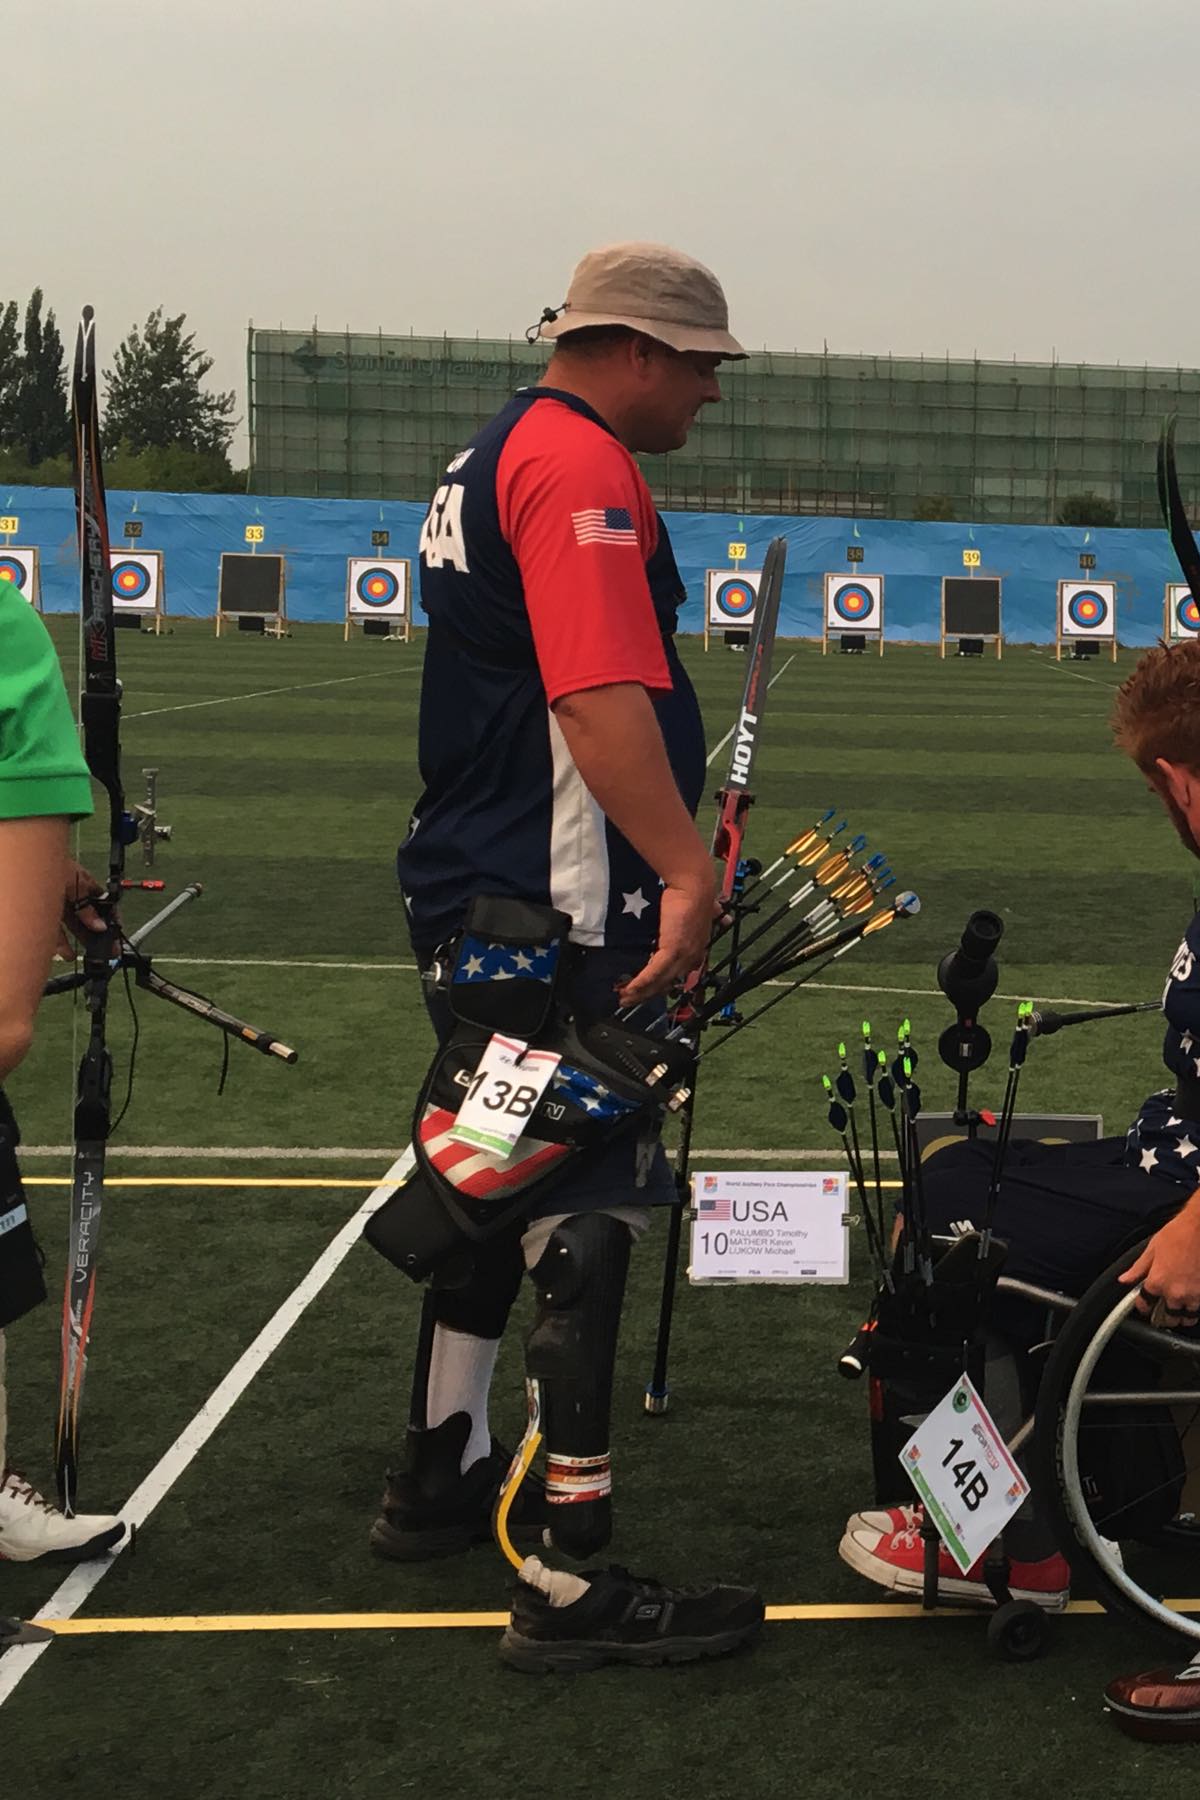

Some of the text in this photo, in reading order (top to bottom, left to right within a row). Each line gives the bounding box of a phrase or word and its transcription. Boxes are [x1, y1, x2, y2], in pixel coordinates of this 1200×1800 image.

[0, 519, 16, 530] 31
[124, 523, 142, 536] 32
[246, 528, 262, 539] 33
[730, 546, 746, 557] 37
[847, 549, 864, 561] 38
[964, 552, 979, 563] 39
[730, 706, 758, 785] HOYT
[467, 1071, 539, 1119] 13B
[732, 1200, 789, 1222] USA
[75, 1171, 95, 1283] VERACITY
[729, 1229, 809, 1239] PALUMBO Timothy
[701, 1232, 729, 1255] 10
[730, 1238, 793, 1246] MATHER Kevin
[765, 1247, 796, 1255] Michael
[942, 1438, 990, 1512] 14B
